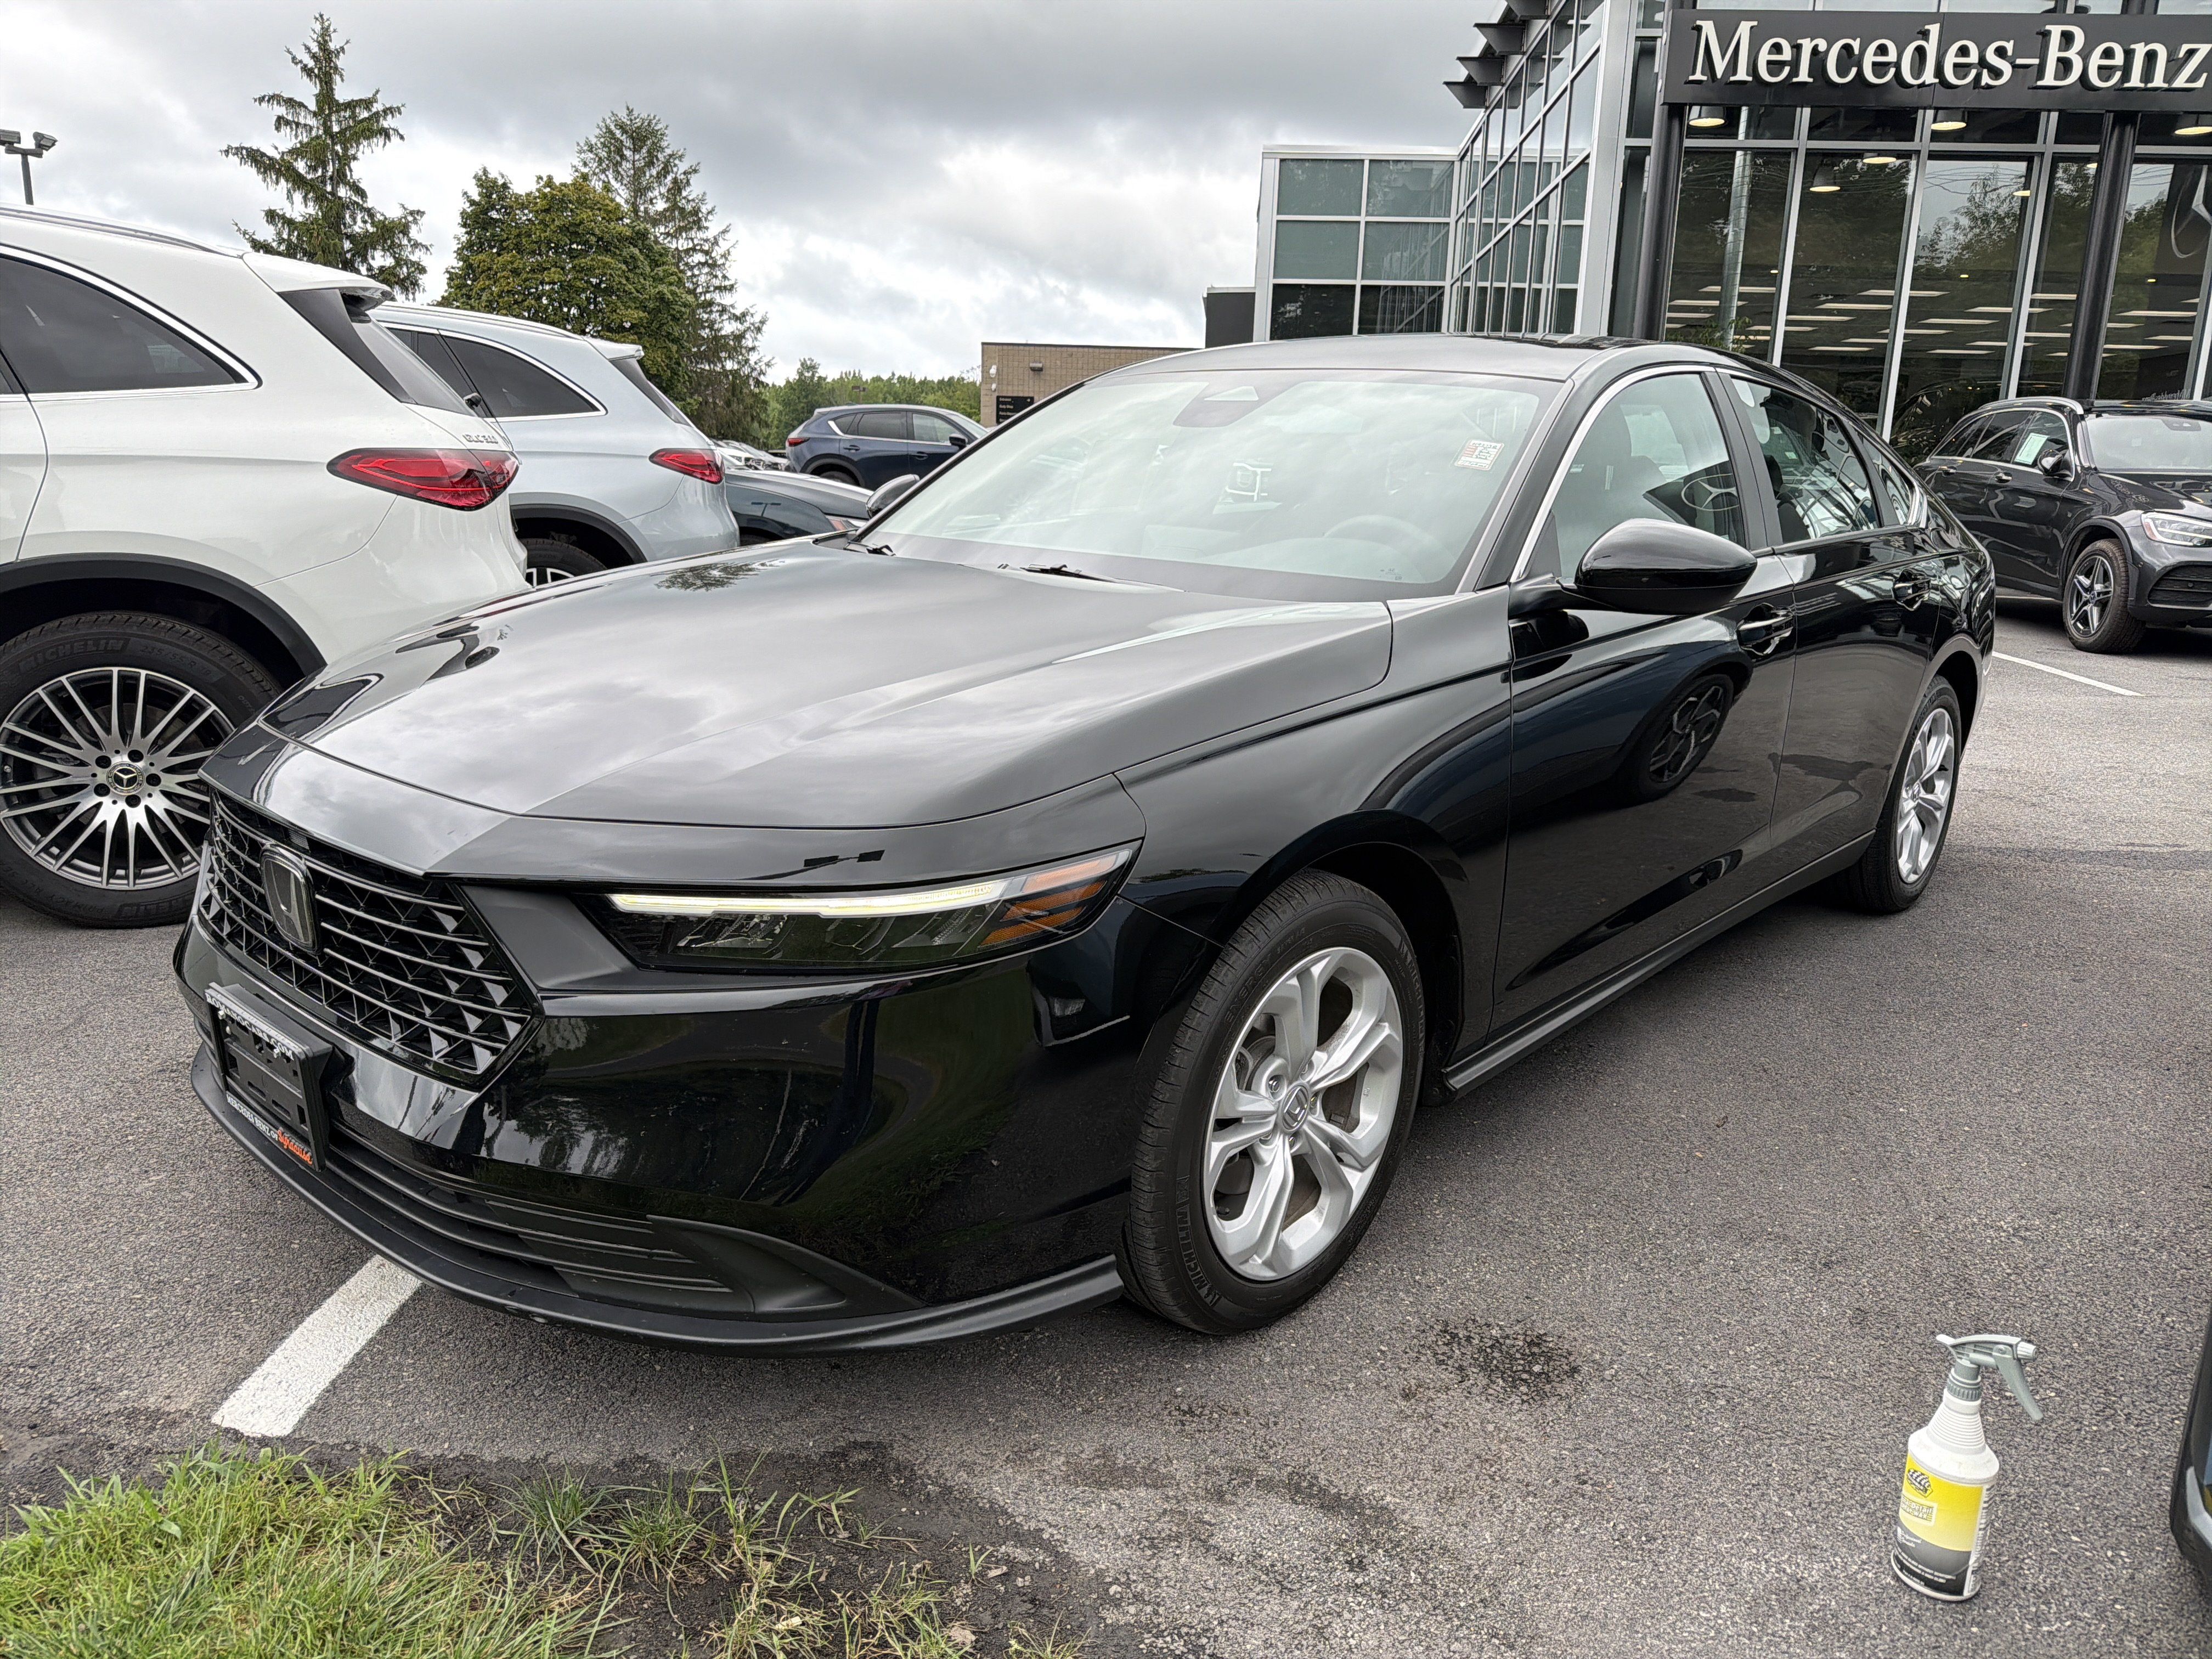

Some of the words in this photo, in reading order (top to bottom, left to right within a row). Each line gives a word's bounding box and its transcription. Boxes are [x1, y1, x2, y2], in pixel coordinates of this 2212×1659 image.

[1688, 20, 2211, 89] Mercedes-Benz
[19, 639, 124, 673] MICHELIN
[1223, 953, 1272, 1024] ENERGY
[1177, 1206, 1211, 1289] MICHELIN
